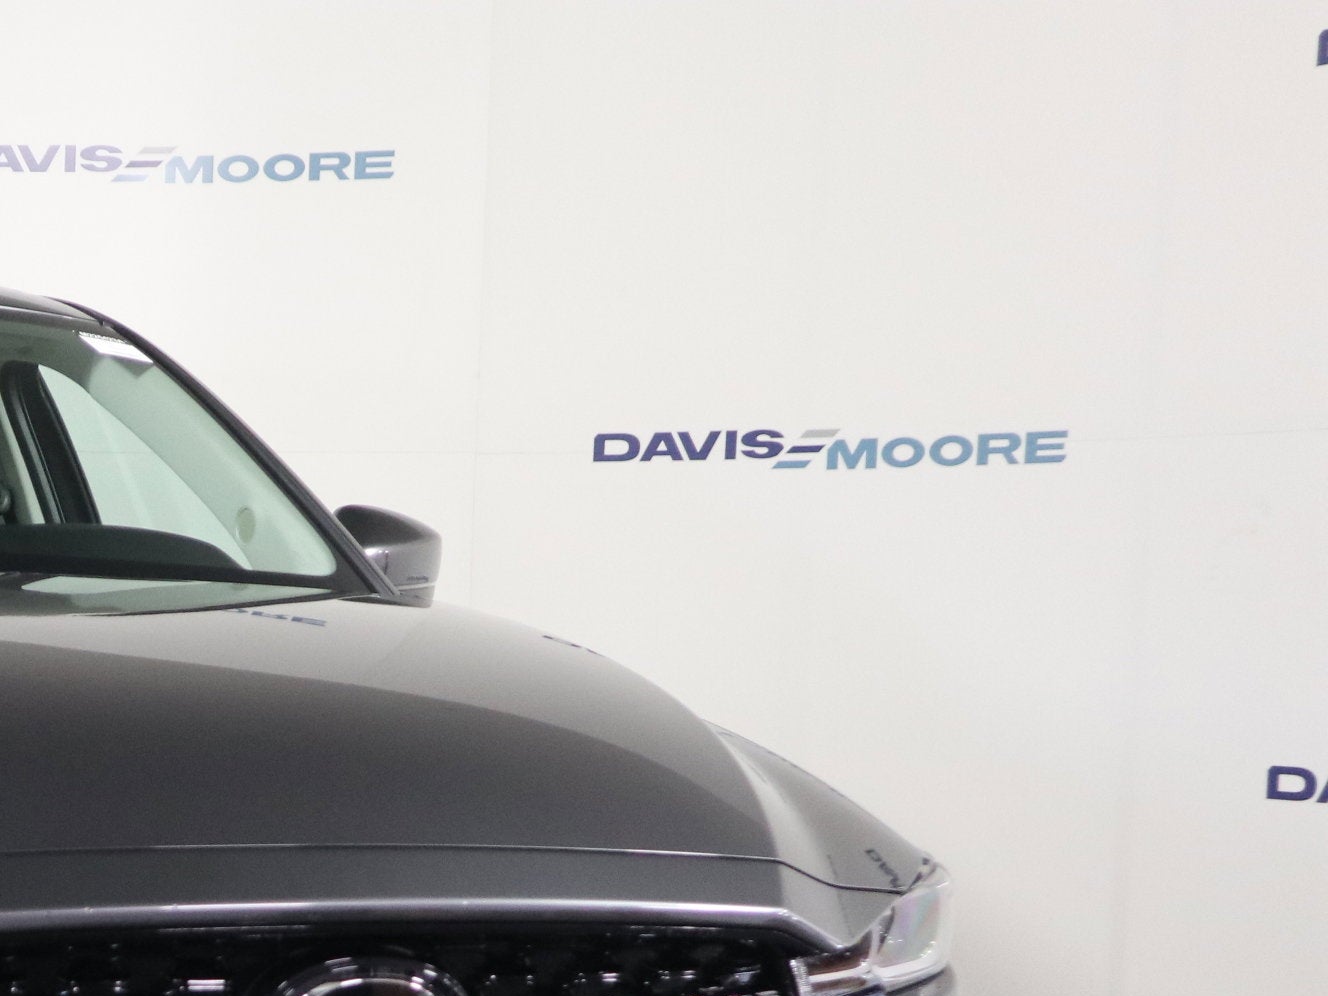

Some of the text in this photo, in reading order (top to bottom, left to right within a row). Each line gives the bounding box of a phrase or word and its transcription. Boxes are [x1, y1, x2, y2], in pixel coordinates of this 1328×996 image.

[164, 149, 396, 185] MOORE
[593, 429, 1069, 470] DAVIS MOORE
